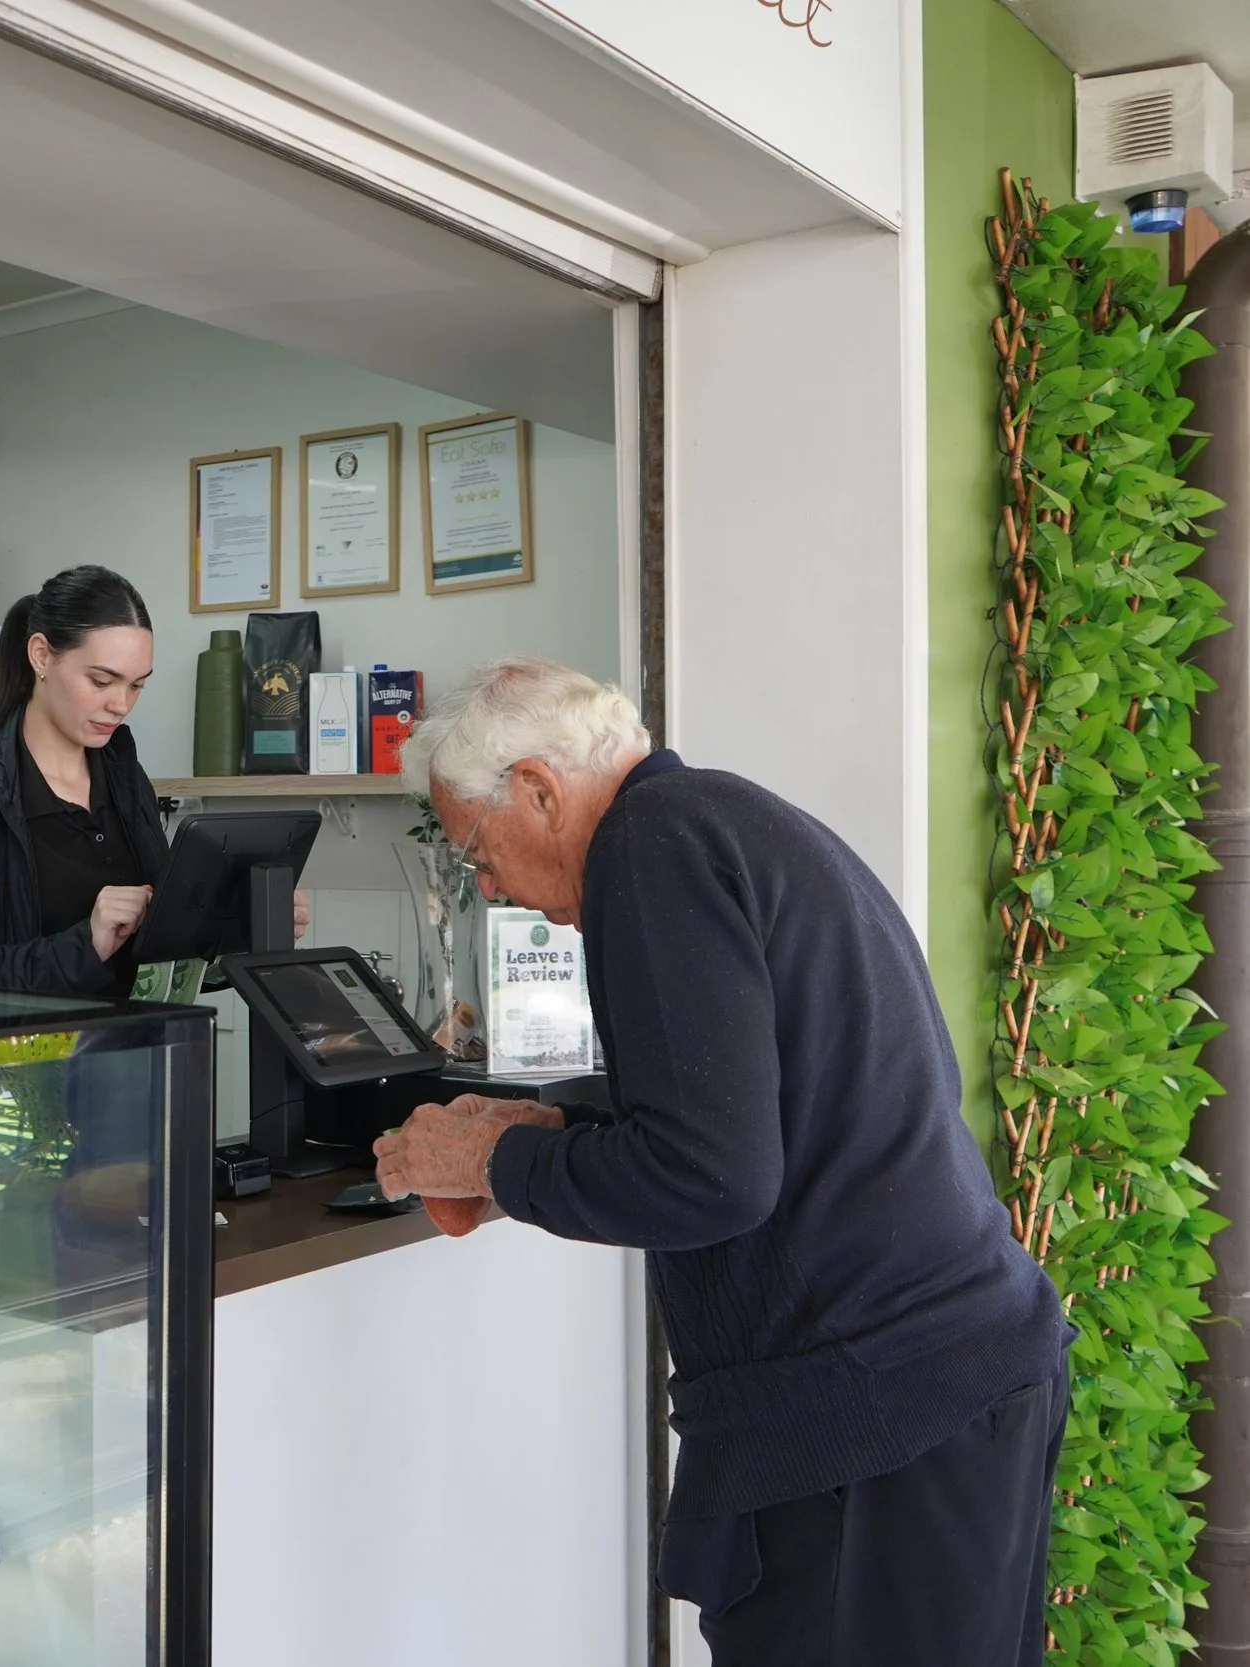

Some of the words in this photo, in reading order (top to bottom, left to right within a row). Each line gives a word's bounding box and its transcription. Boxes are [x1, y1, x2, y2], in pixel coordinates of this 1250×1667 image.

[471, 437, 507, 459] Safe
[372, 688, 413, 703] ALTERNATIVE
[505, 949, 559, 964] Leave
[563, 951, 574, 963] a
[507, 965, 574, 982] Review
